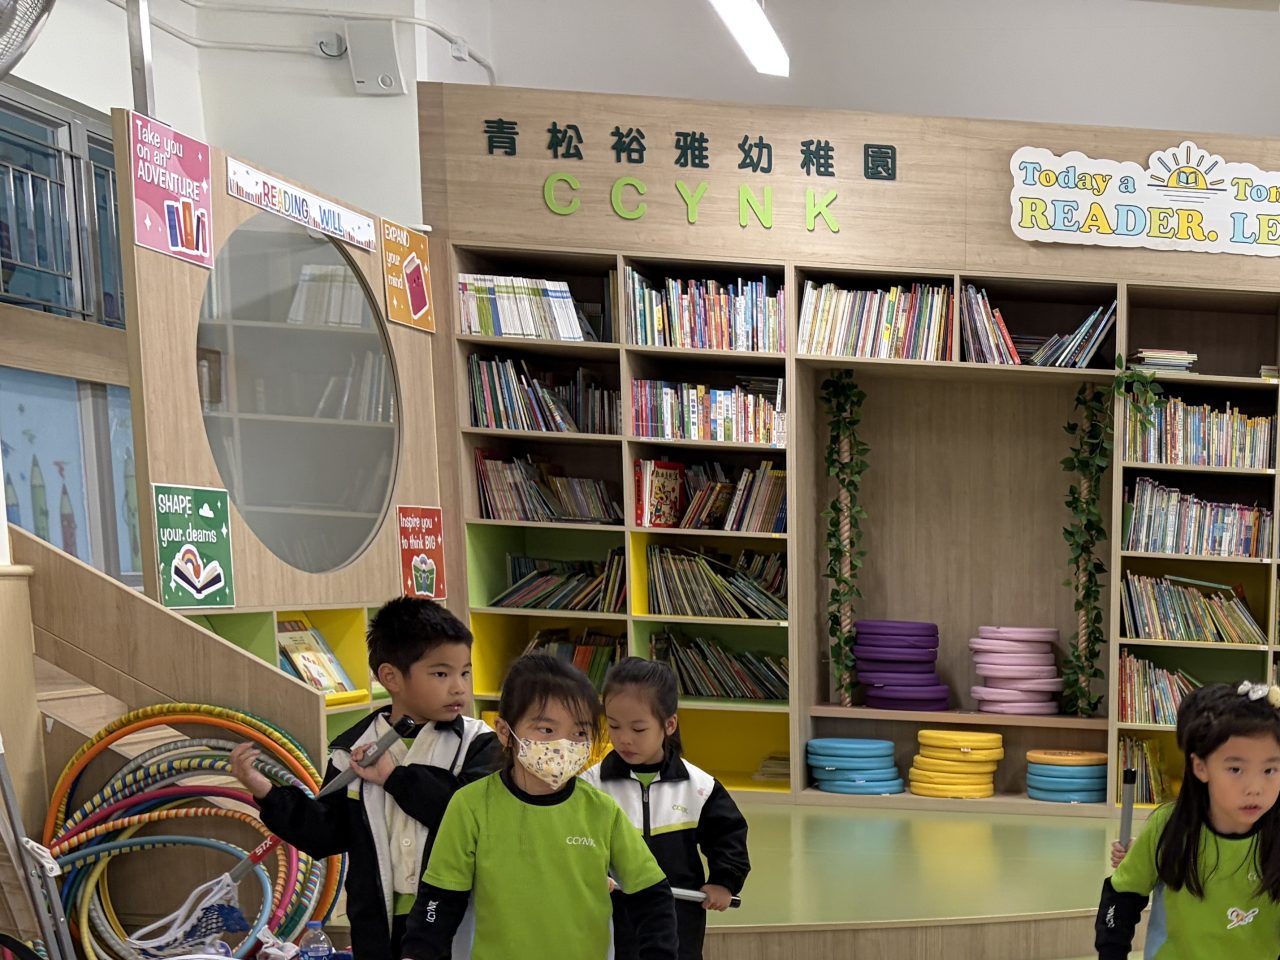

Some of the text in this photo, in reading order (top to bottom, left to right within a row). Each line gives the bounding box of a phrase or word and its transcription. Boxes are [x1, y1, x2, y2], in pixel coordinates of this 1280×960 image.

[136, 119, 183, 158] Take you
[483, 118, 898, 180] 青松裕雅幼稚園
[137, 144, 168, 167] on an
[137, 159, 200, 200] ADVENTURE
[1019, 161, 1137, 196] Today a
[262, 181, 345, 233] READING WILL
[1018, 197, 1219, 242] READER.
[384, 223, 410, 248] EXPAND
[386, 251, 401, 267] your
[388, 271, 404, 289] mind
[158, 494, 192, 514] SHAPE
[160, 522, 217, 547] your deams
[400, 513, 433, 532] Inspire you
[401, 534, 435, 550] to think BIG
